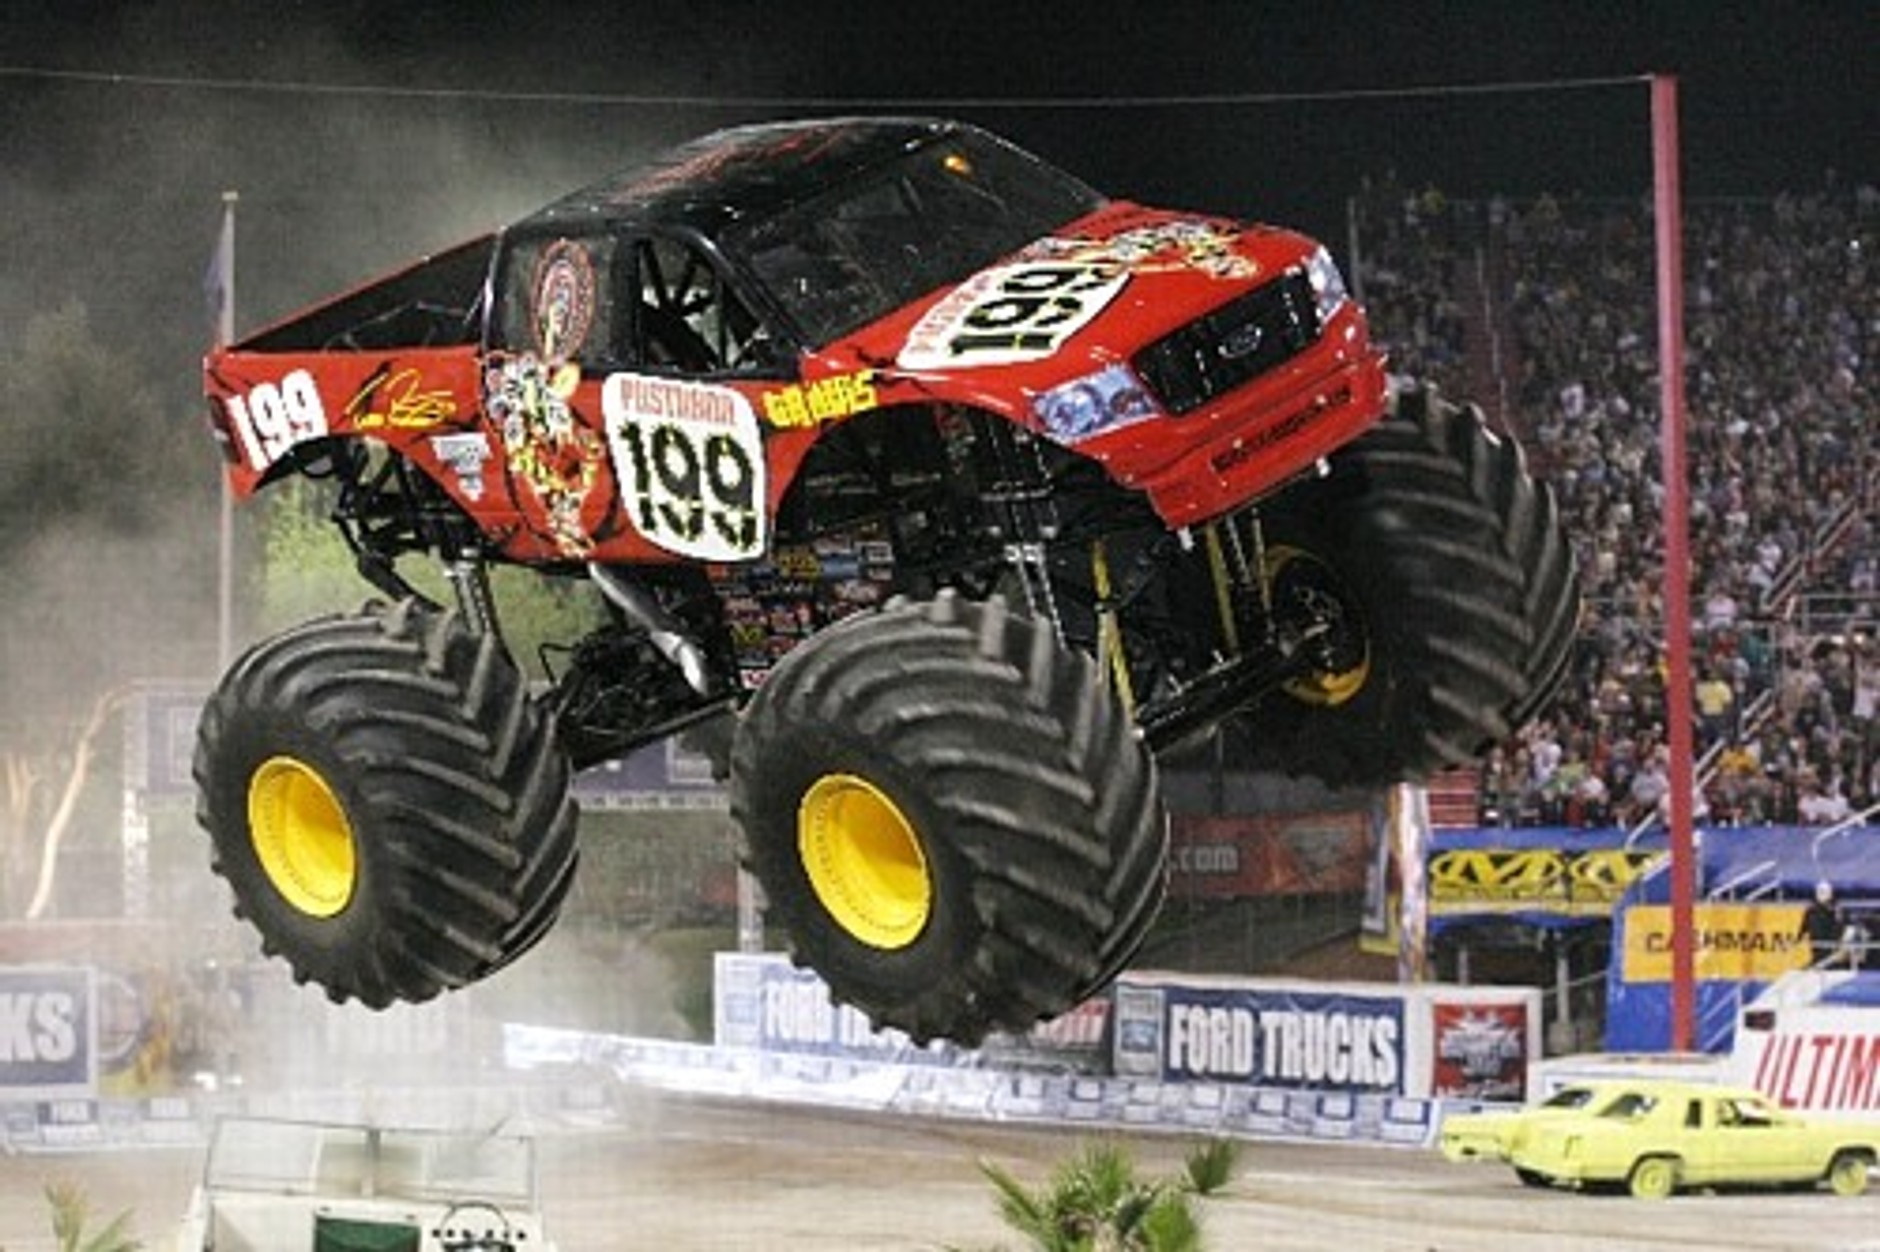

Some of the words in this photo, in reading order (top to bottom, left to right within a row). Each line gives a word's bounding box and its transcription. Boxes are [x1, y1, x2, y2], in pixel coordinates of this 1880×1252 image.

[226, 368, 329, 472] 199
[1168, 1004, 1254, 1076] FORD
[1259, 1011, 1399, 1087] TRUCKS
